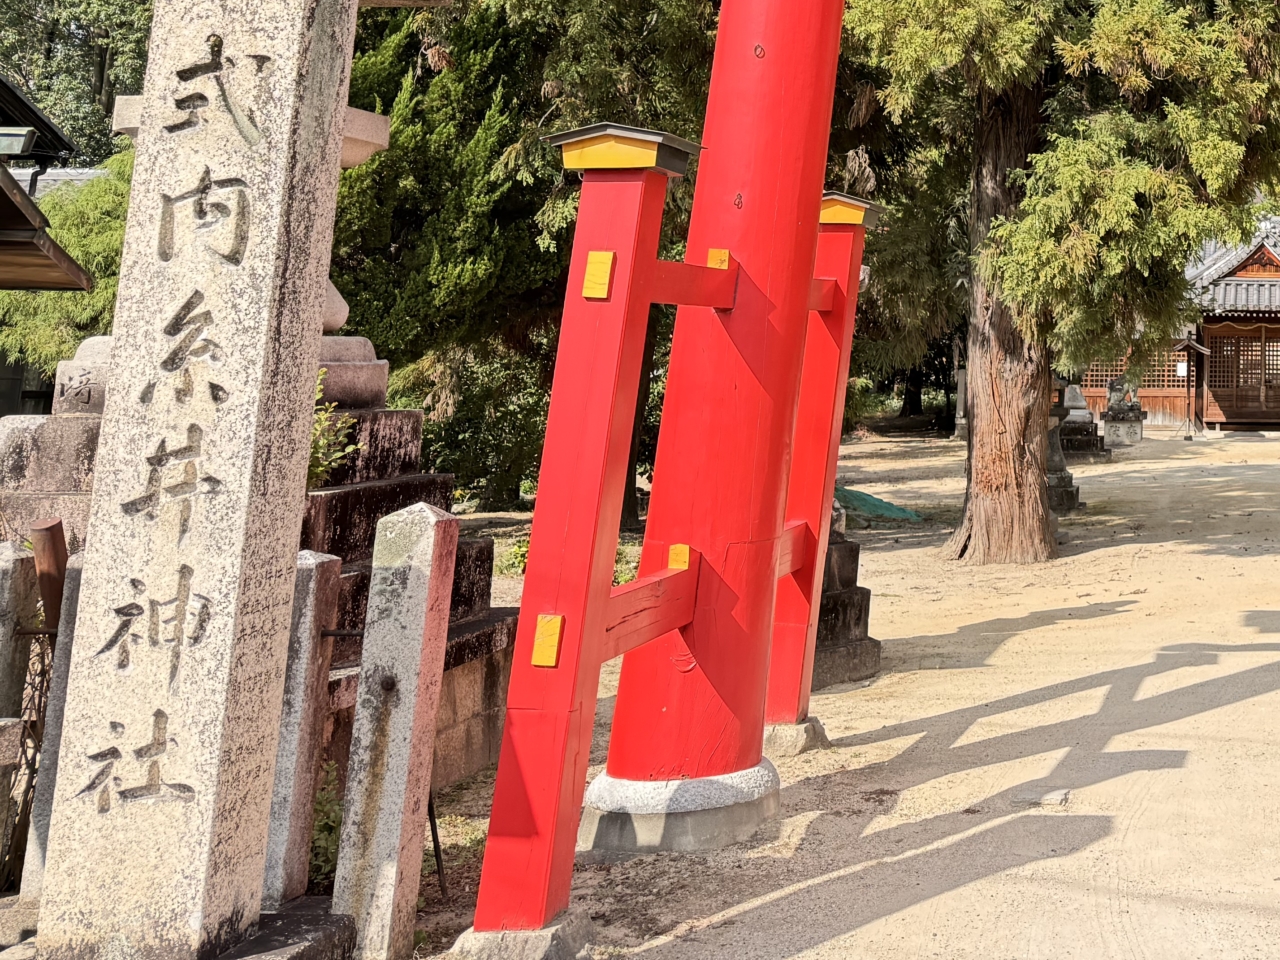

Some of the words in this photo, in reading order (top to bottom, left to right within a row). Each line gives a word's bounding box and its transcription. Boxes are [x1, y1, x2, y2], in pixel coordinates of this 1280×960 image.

[72, 32, 272, 815] 式内糸井神社
